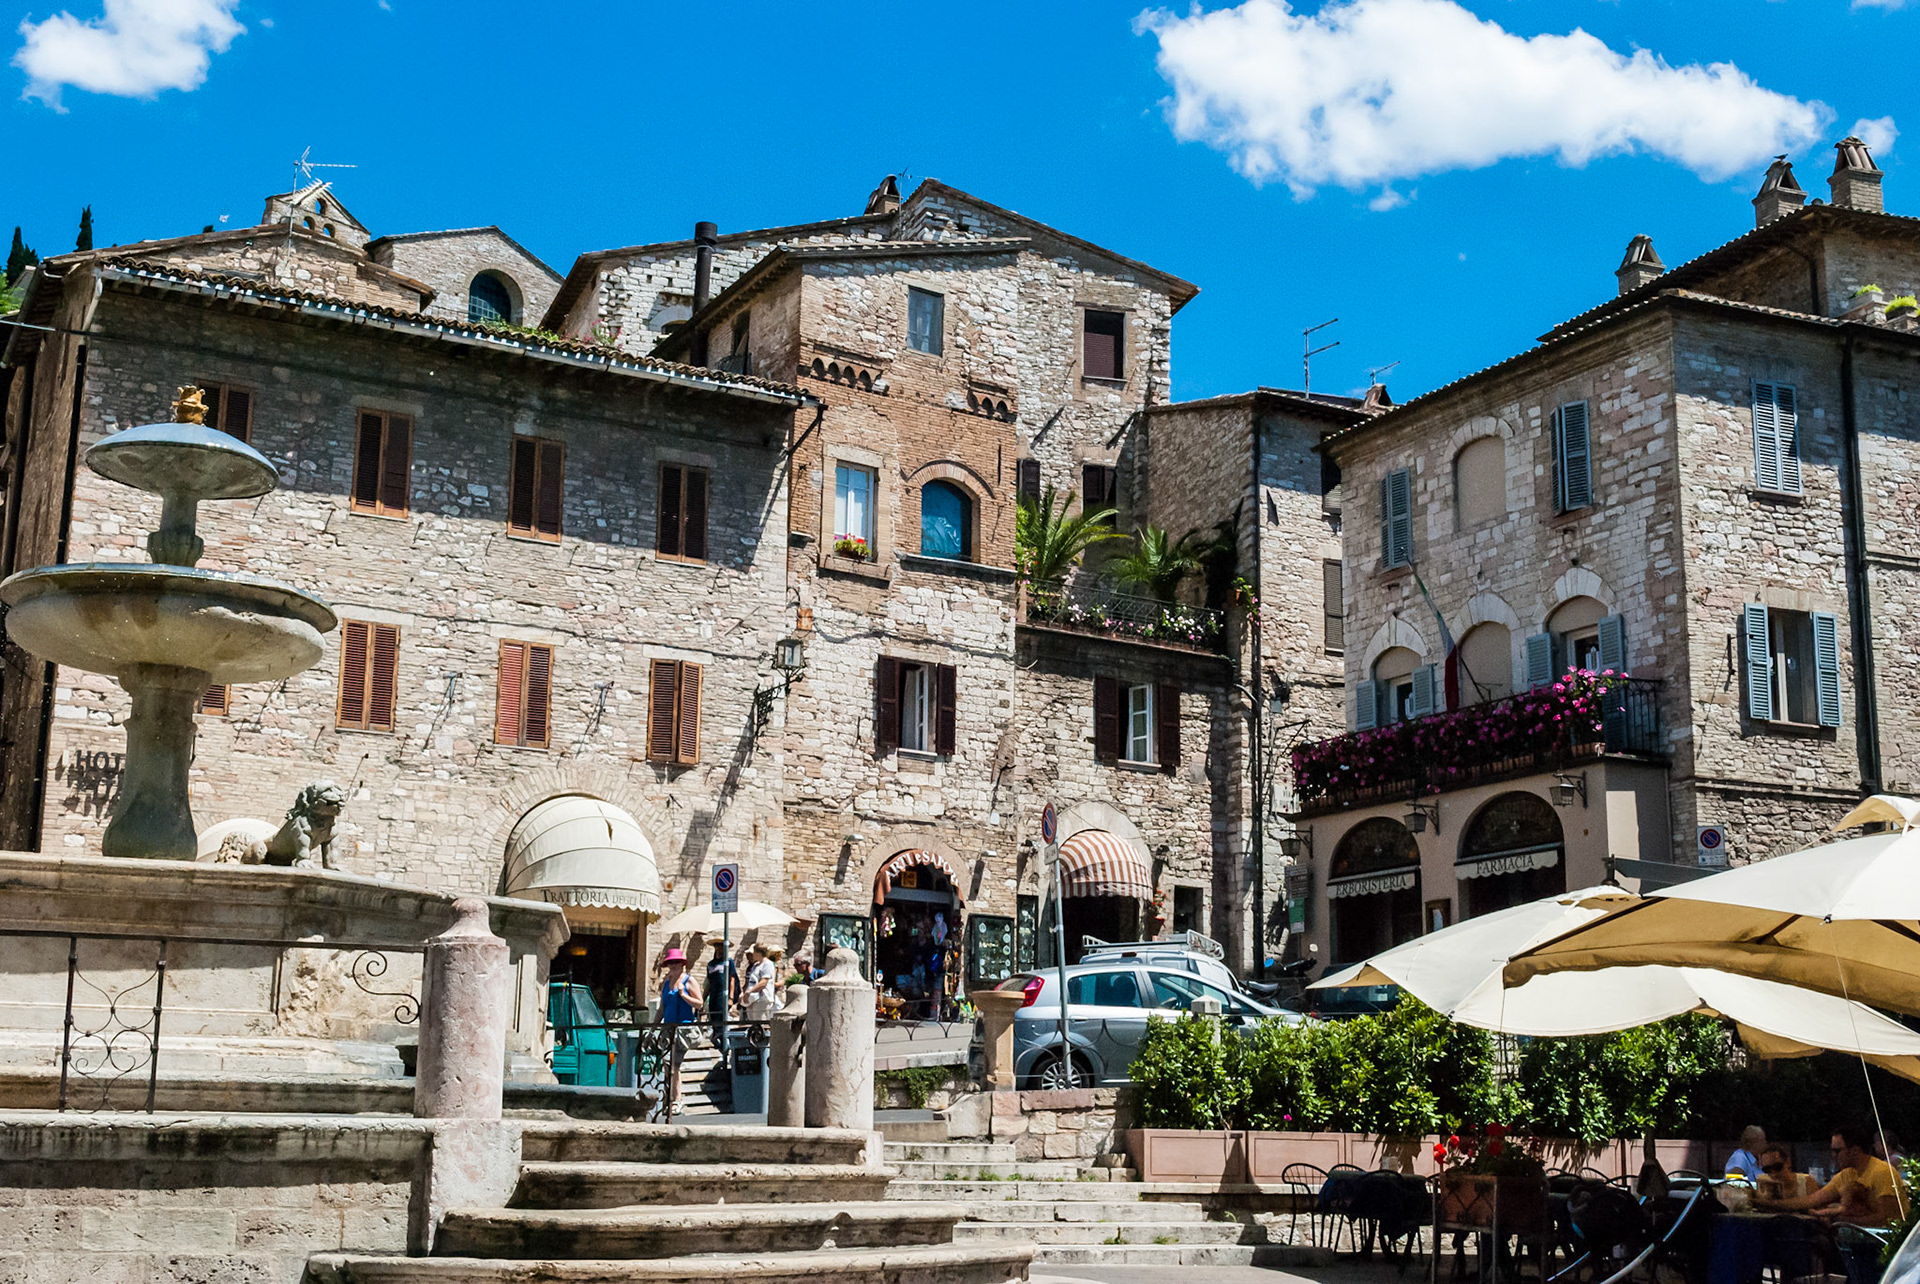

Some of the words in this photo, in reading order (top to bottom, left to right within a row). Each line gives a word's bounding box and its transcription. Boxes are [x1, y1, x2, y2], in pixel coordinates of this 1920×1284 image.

[77, 750, 126, 774] HOT
[885, 853, 913, 884] ARTI
[914, 853, 922, 864] e
[1476, 854, 1534, 875] FARMACIA
[1336, 876, 1407, 896] ERBORISTERIA
[541, 888, 610, 903] TRATTORIA
[612, 894, 637, 907] DEGLI
